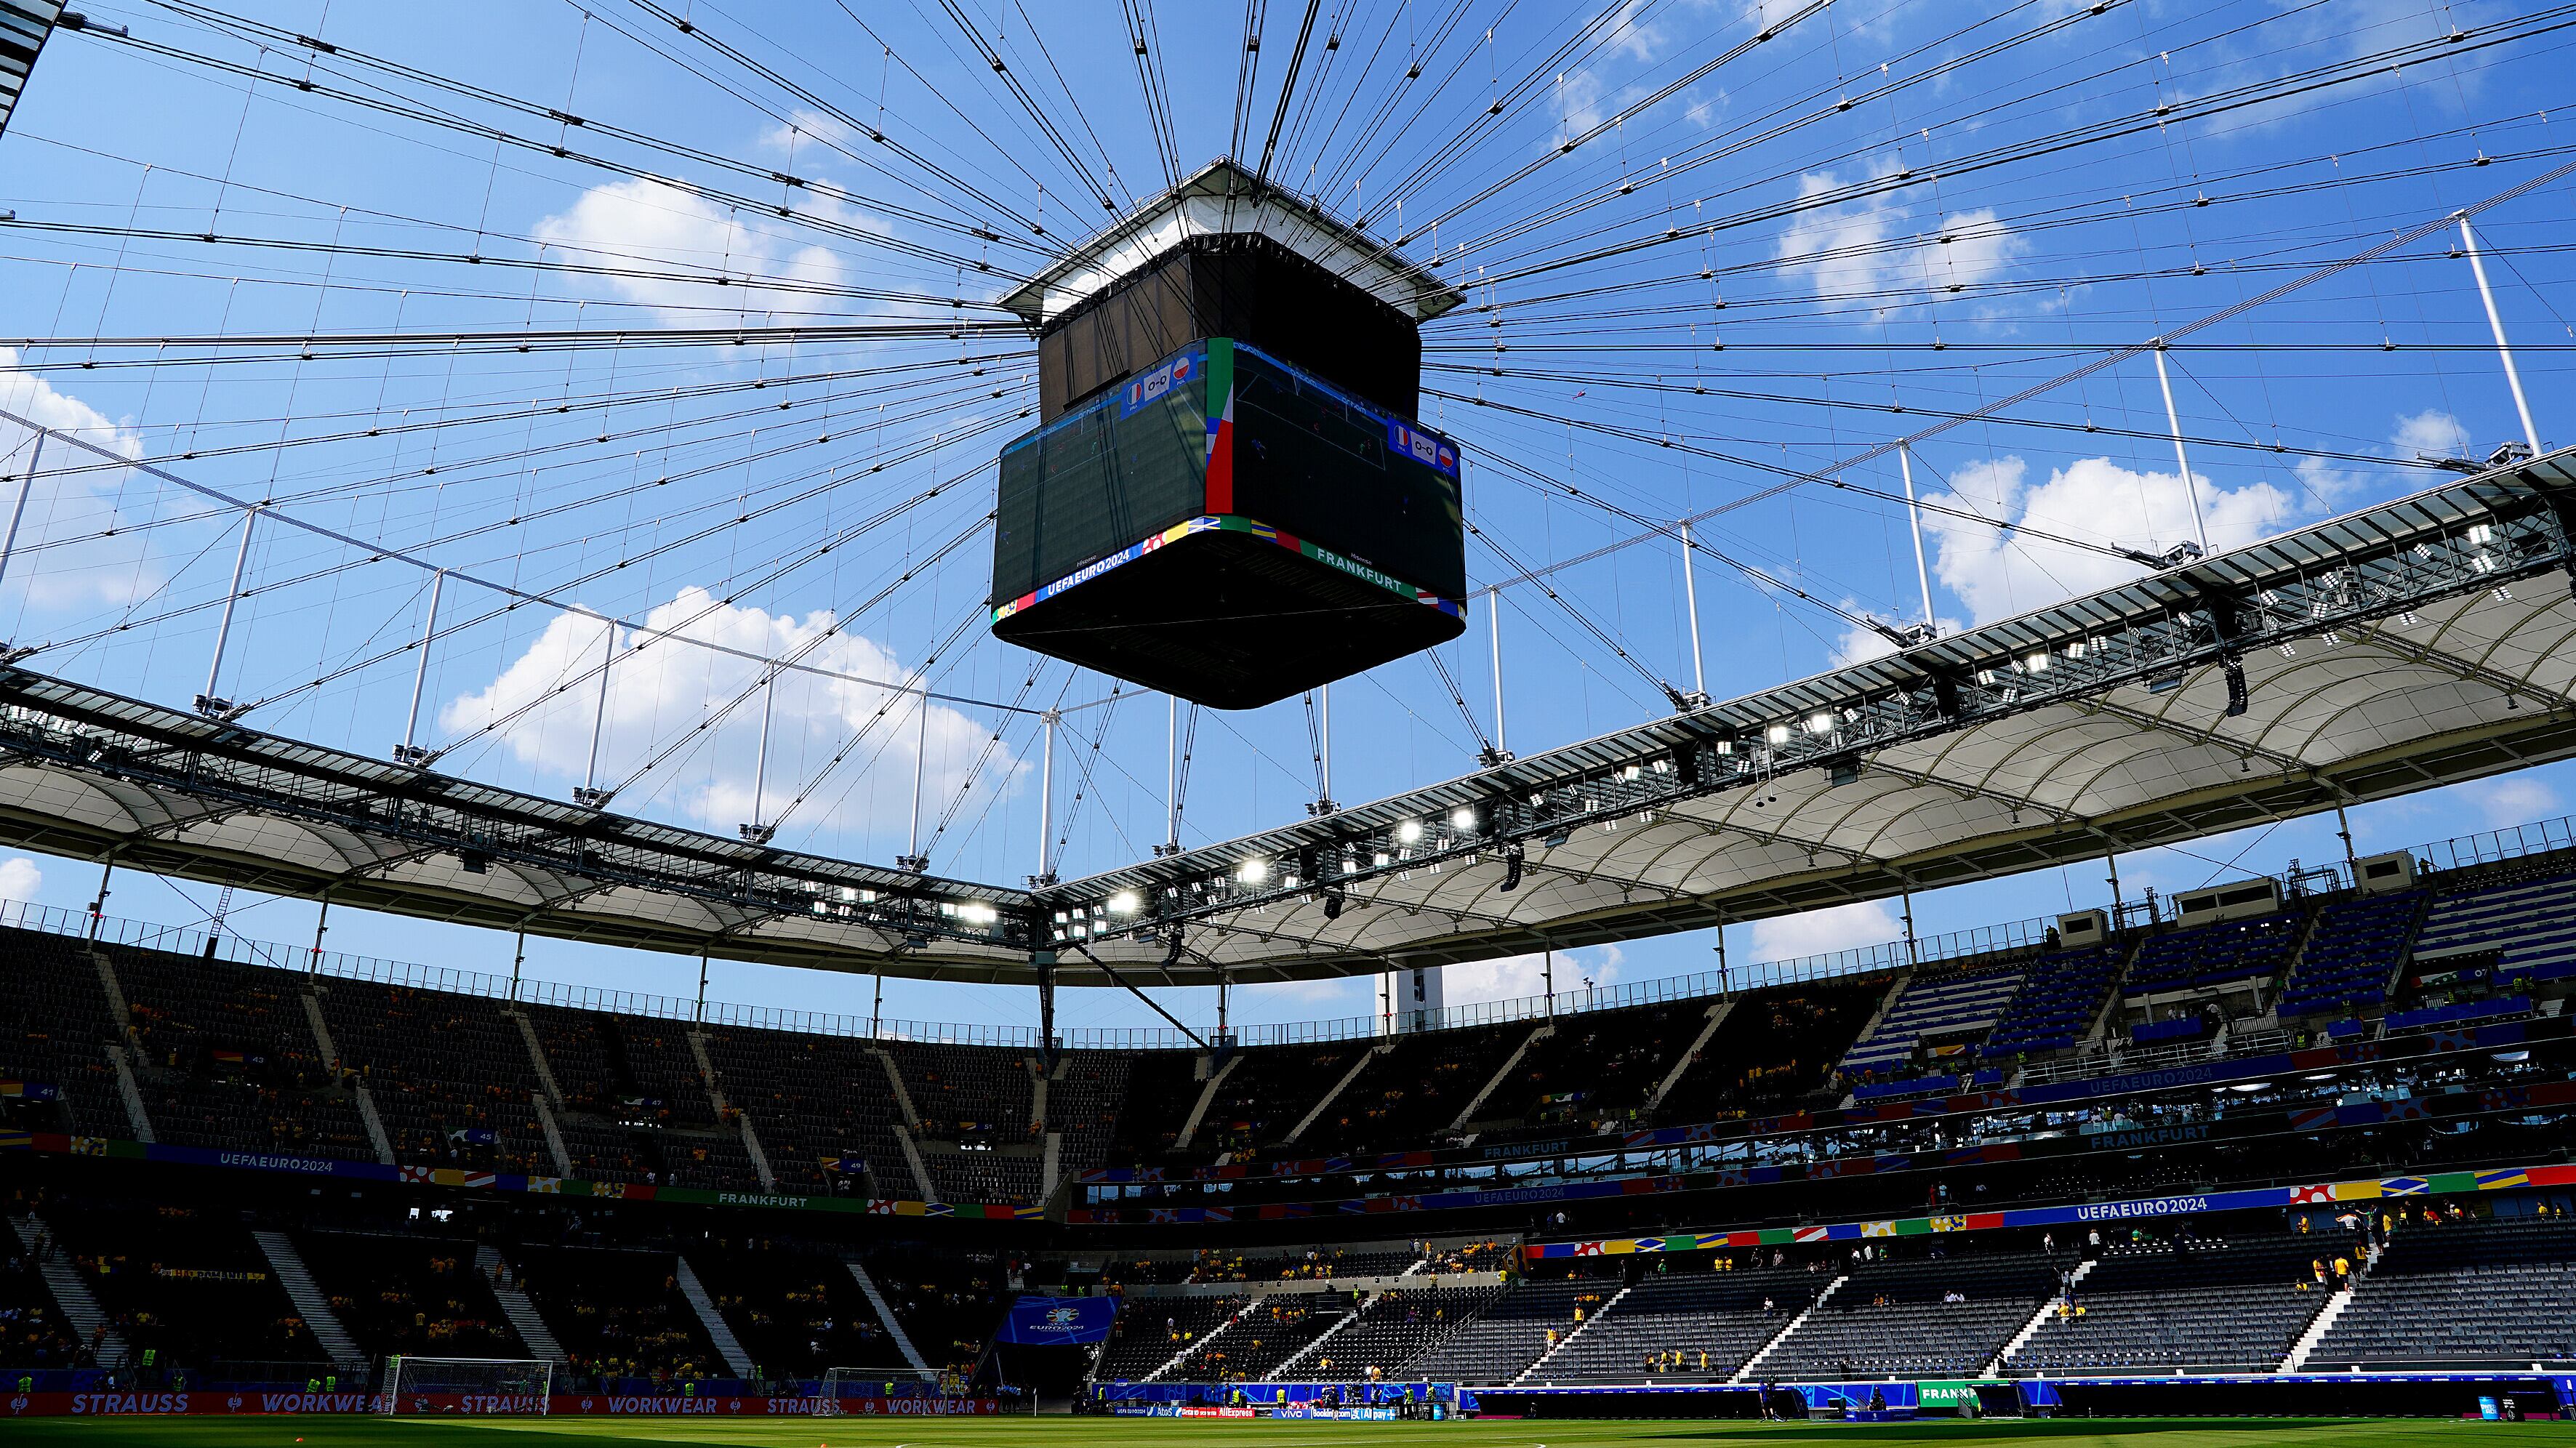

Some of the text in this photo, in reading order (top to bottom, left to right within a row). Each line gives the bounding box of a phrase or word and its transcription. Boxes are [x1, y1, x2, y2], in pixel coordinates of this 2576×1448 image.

[1148, 375, 1166, 391] 0-0
[1415, 441, 1433, 456] 0-0
[1076, 555, 1096, 567] Hisense
[1351, 552, 1372, 566] Hisense
[1317, 548, 1402, 592] FRANKFURT
[2091, 1125, 2210, 1149] FRANKFURT
[1484, 1141, 1568, 1158] FRANKFURT
[718, 1193, 807, 1207] FRANKFURT
[71, 1394, 189, 1413] STRAUSS
[608, 1396, 717, 1413] WORKWEAR
[767, 1399, 840, 1414] STRAUSS
[886, 1399, 976, 1414] WORKWEAR
[1157, 1408, 1173, 1417] Atos
[1219, 1407, 1252, 1418] AliExpress
